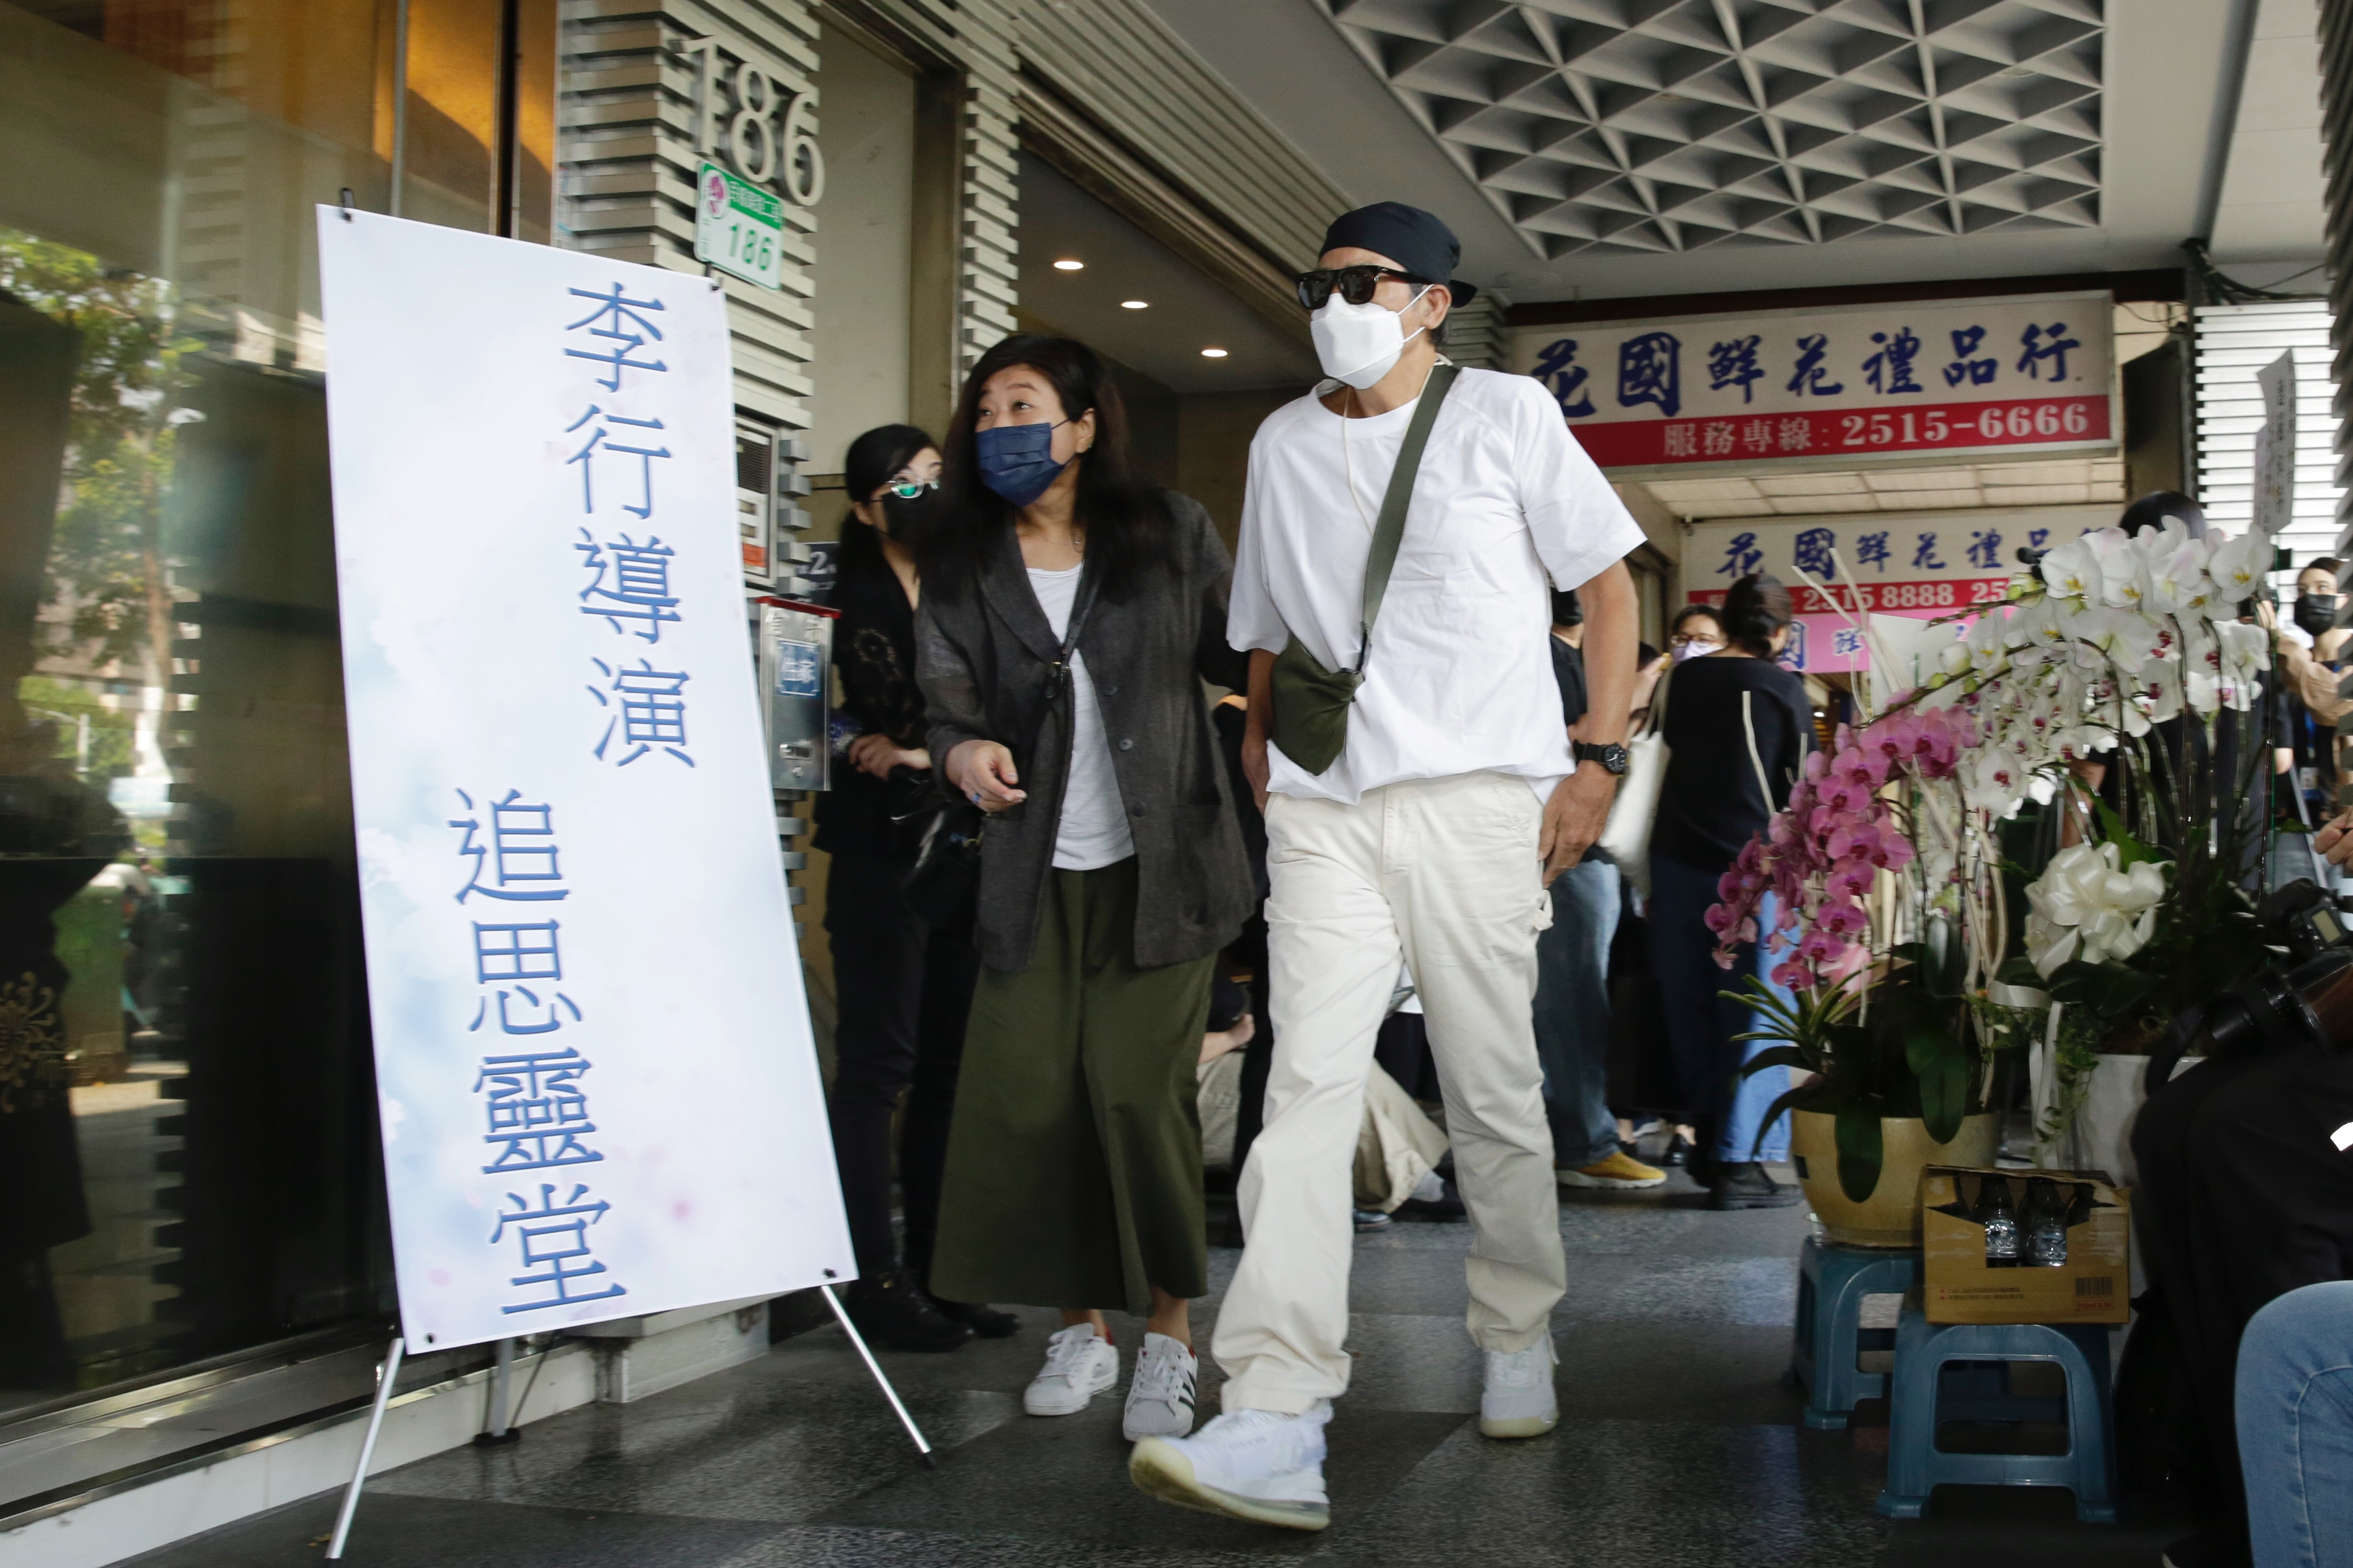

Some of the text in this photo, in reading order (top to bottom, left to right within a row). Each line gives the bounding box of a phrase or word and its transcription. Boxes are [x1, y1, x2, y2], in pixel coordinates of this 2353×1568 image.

[676, 36, 825, 206] 186
[729, 223, 774, 271] 186
[1530, 322, 2080, 418] 花國鮮花禮品行
[1841, 403, 2087, 446] 2515-6666
[563, 282, 695, 768] 李行導演
[1881, 583, 1954, 608] 8888
[447, 788, 627, 1315] 追思靈堂
